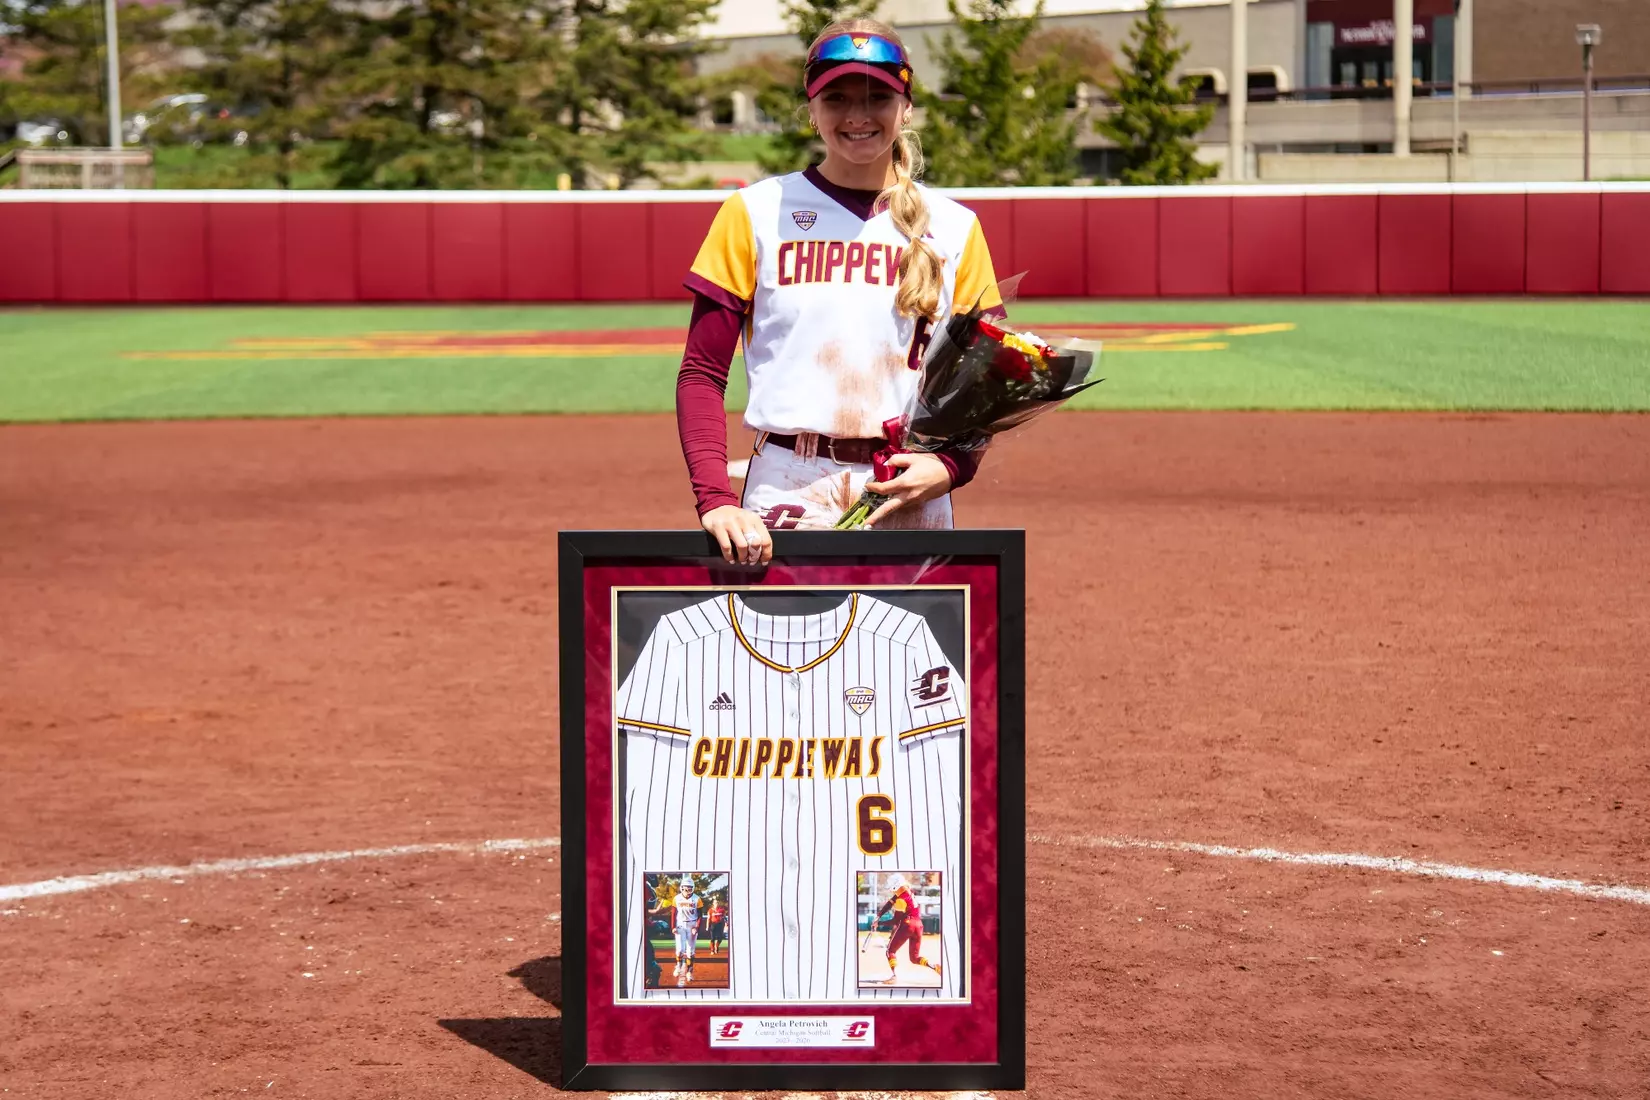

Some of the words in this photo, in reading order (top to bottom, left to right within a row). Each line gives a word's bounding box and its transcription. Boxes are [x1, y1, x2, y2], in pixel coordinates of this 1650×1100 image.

[777, 239, 905, 287] CHIPPEW
[708, 702, 736, 711] adidas
[846, 695, 874, 704] MAC
[691, 735, 885, 779] CHIPPEWAS
[855, 793, 897, 856] 6
[759, 1019, 787, 1029] Angela
[789, 1019, 828, 1028] Petrovich
